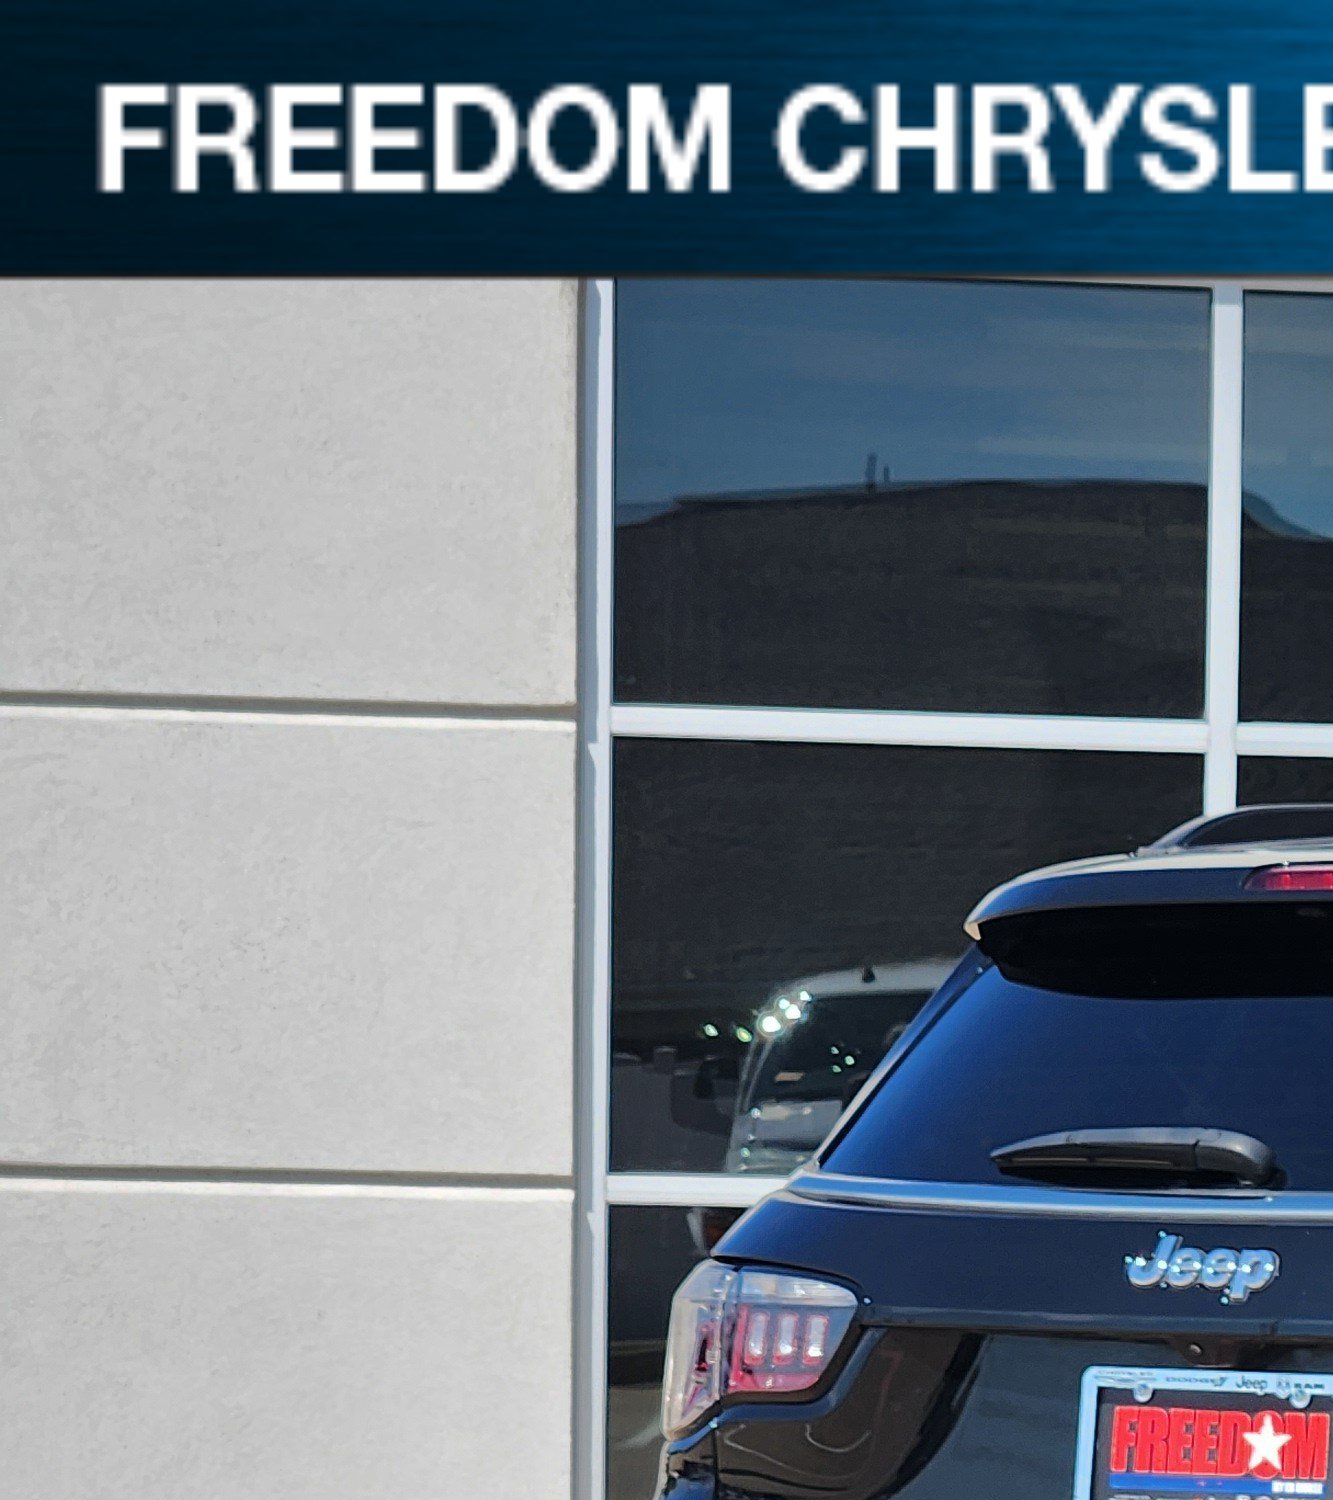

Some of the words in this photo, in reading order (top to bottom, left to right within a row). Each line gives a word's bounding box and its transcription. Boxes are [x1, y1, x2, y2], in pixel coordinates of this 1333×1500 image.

[1125, 1230, 1280, 1304] Jeep
[1235, 1376, 1268, 1391] Jeep
[1110, 1405, 1331, 1480] FREEDOM
